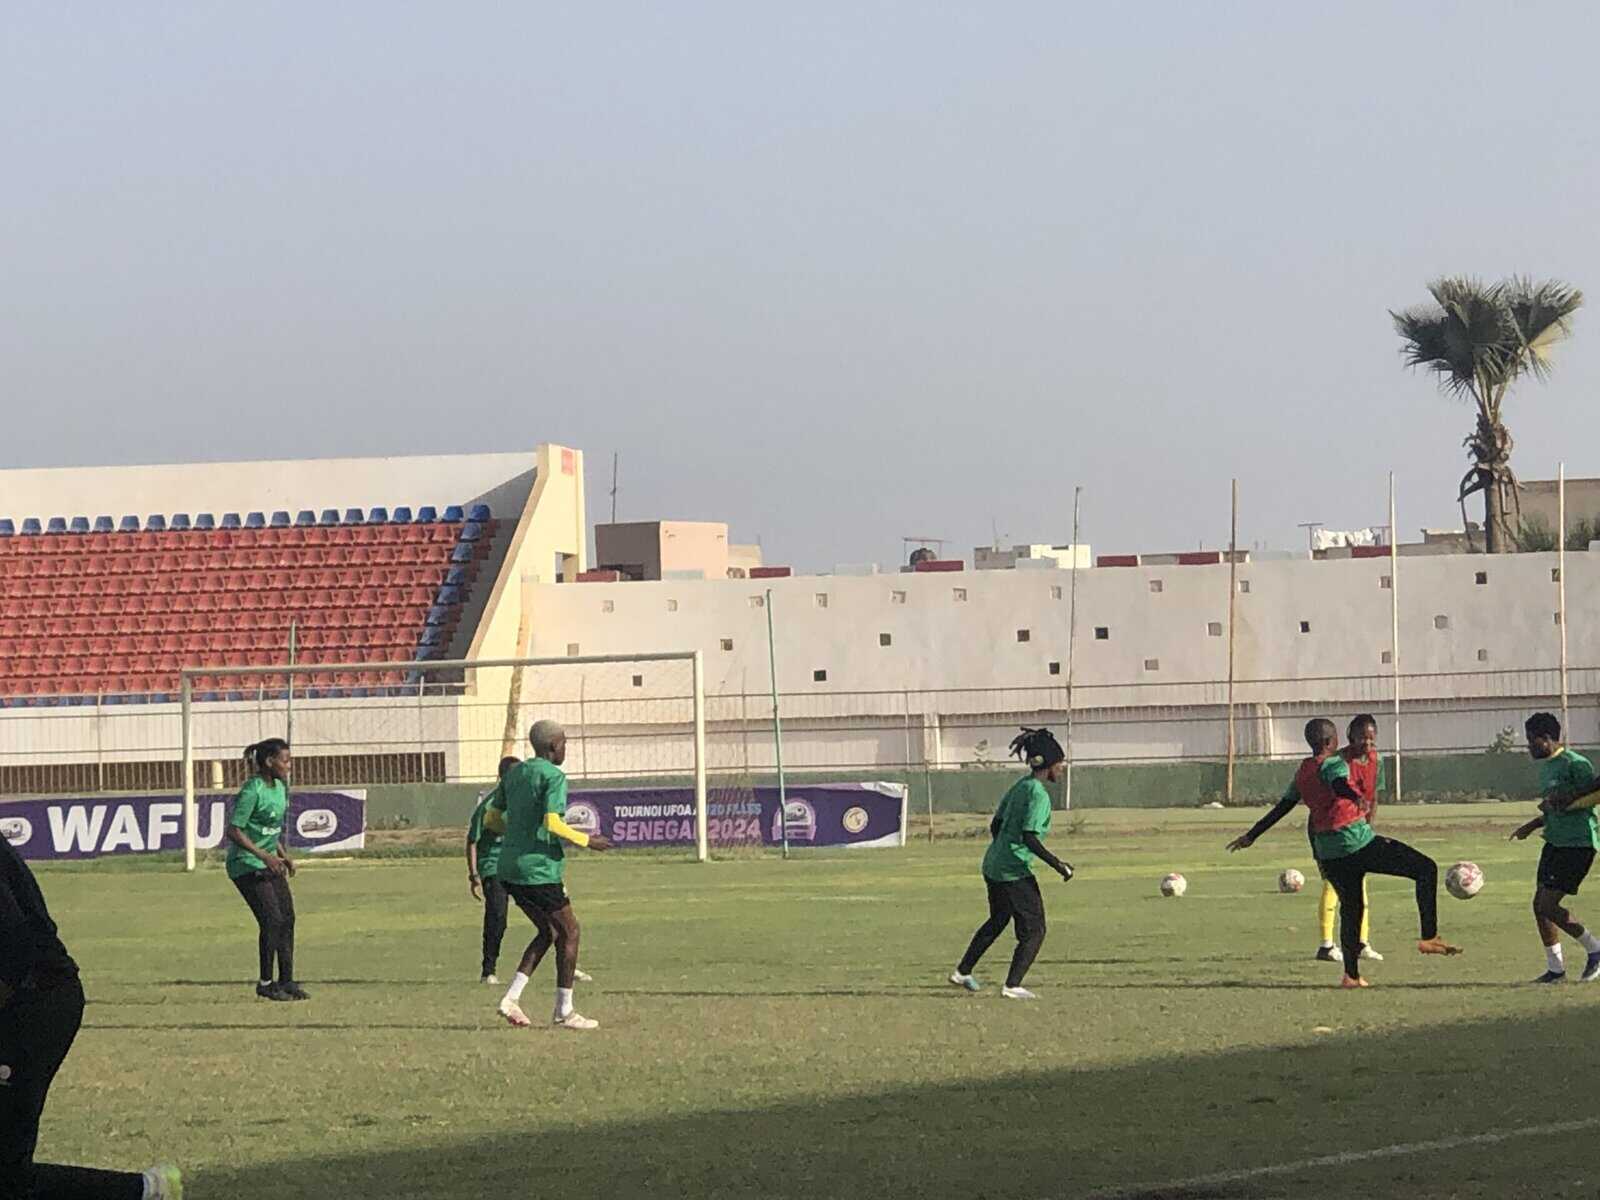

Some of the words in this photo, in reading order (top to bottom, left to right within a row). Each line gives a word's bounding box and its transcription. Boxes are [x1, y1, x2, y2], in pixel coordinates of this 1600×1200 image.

[614, 806, 662, 817] TOURNOI
[663, 804, 692, 816] UFOA
[47, 802, 225, 852] WAFU
[709, 818, 761, 839] 2024
